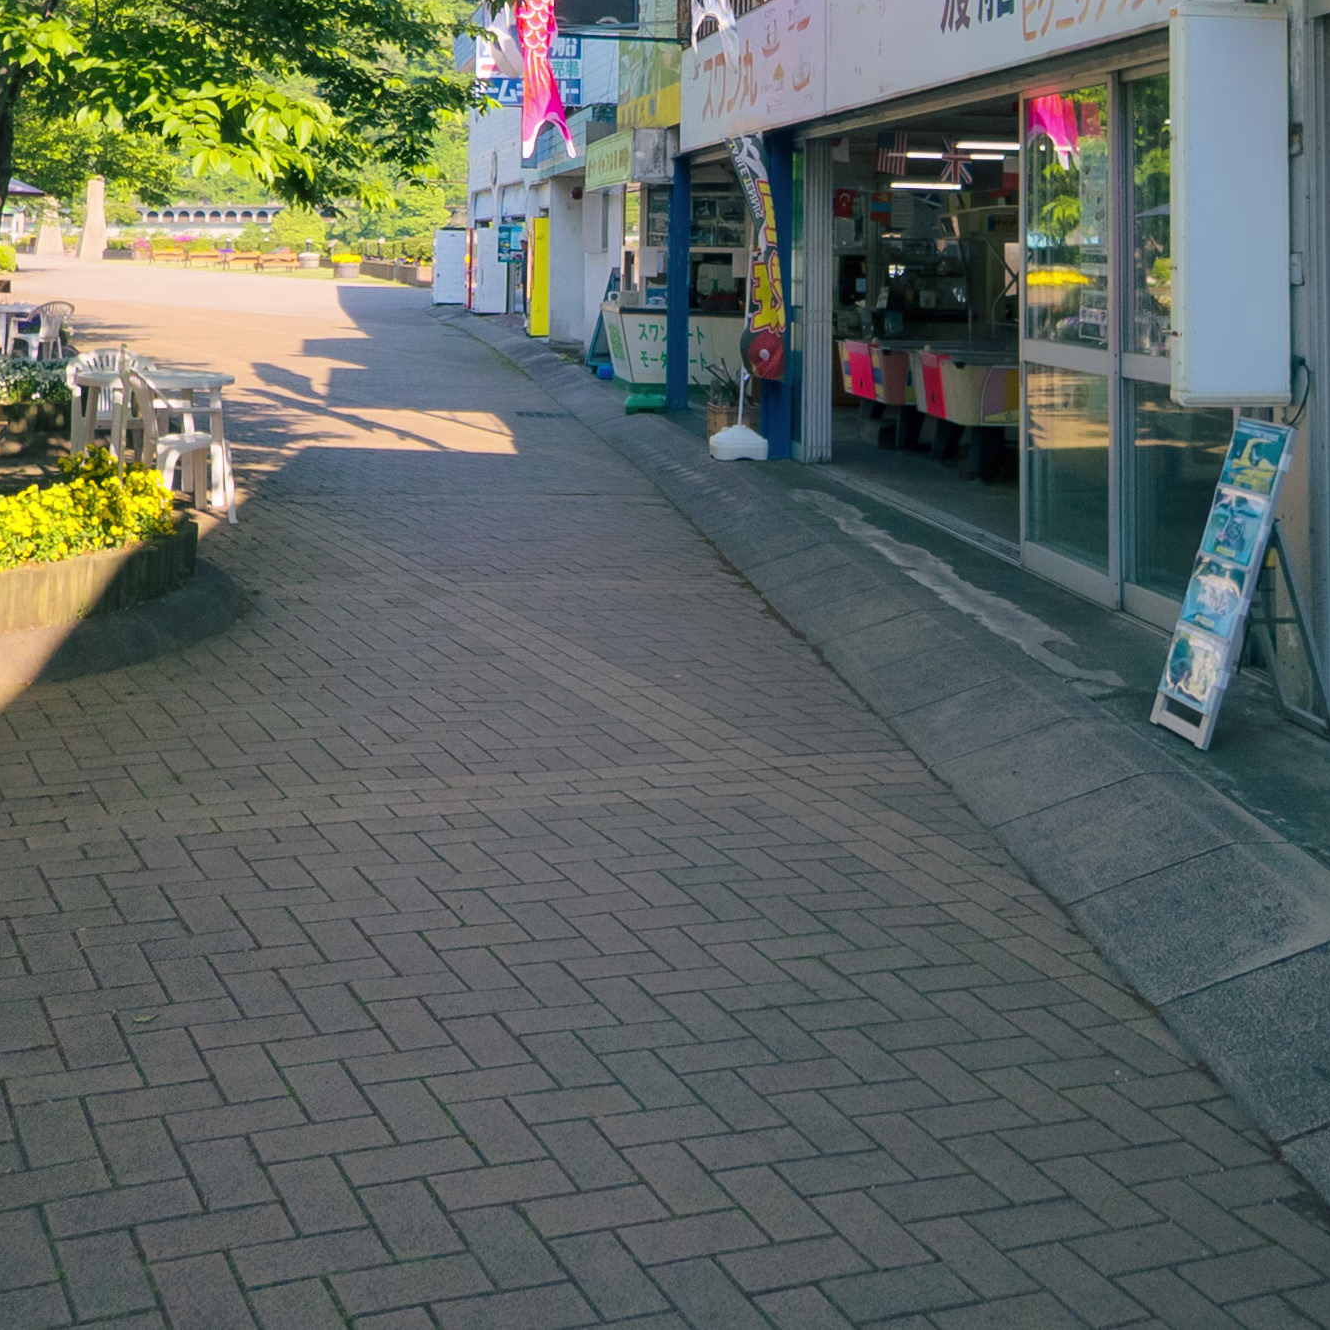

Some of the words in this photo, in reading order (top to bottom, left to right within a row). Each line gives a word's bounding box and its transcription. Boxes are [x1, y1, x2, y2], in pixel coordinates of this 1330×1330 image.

[637, 323, 705, 345] スワンート
